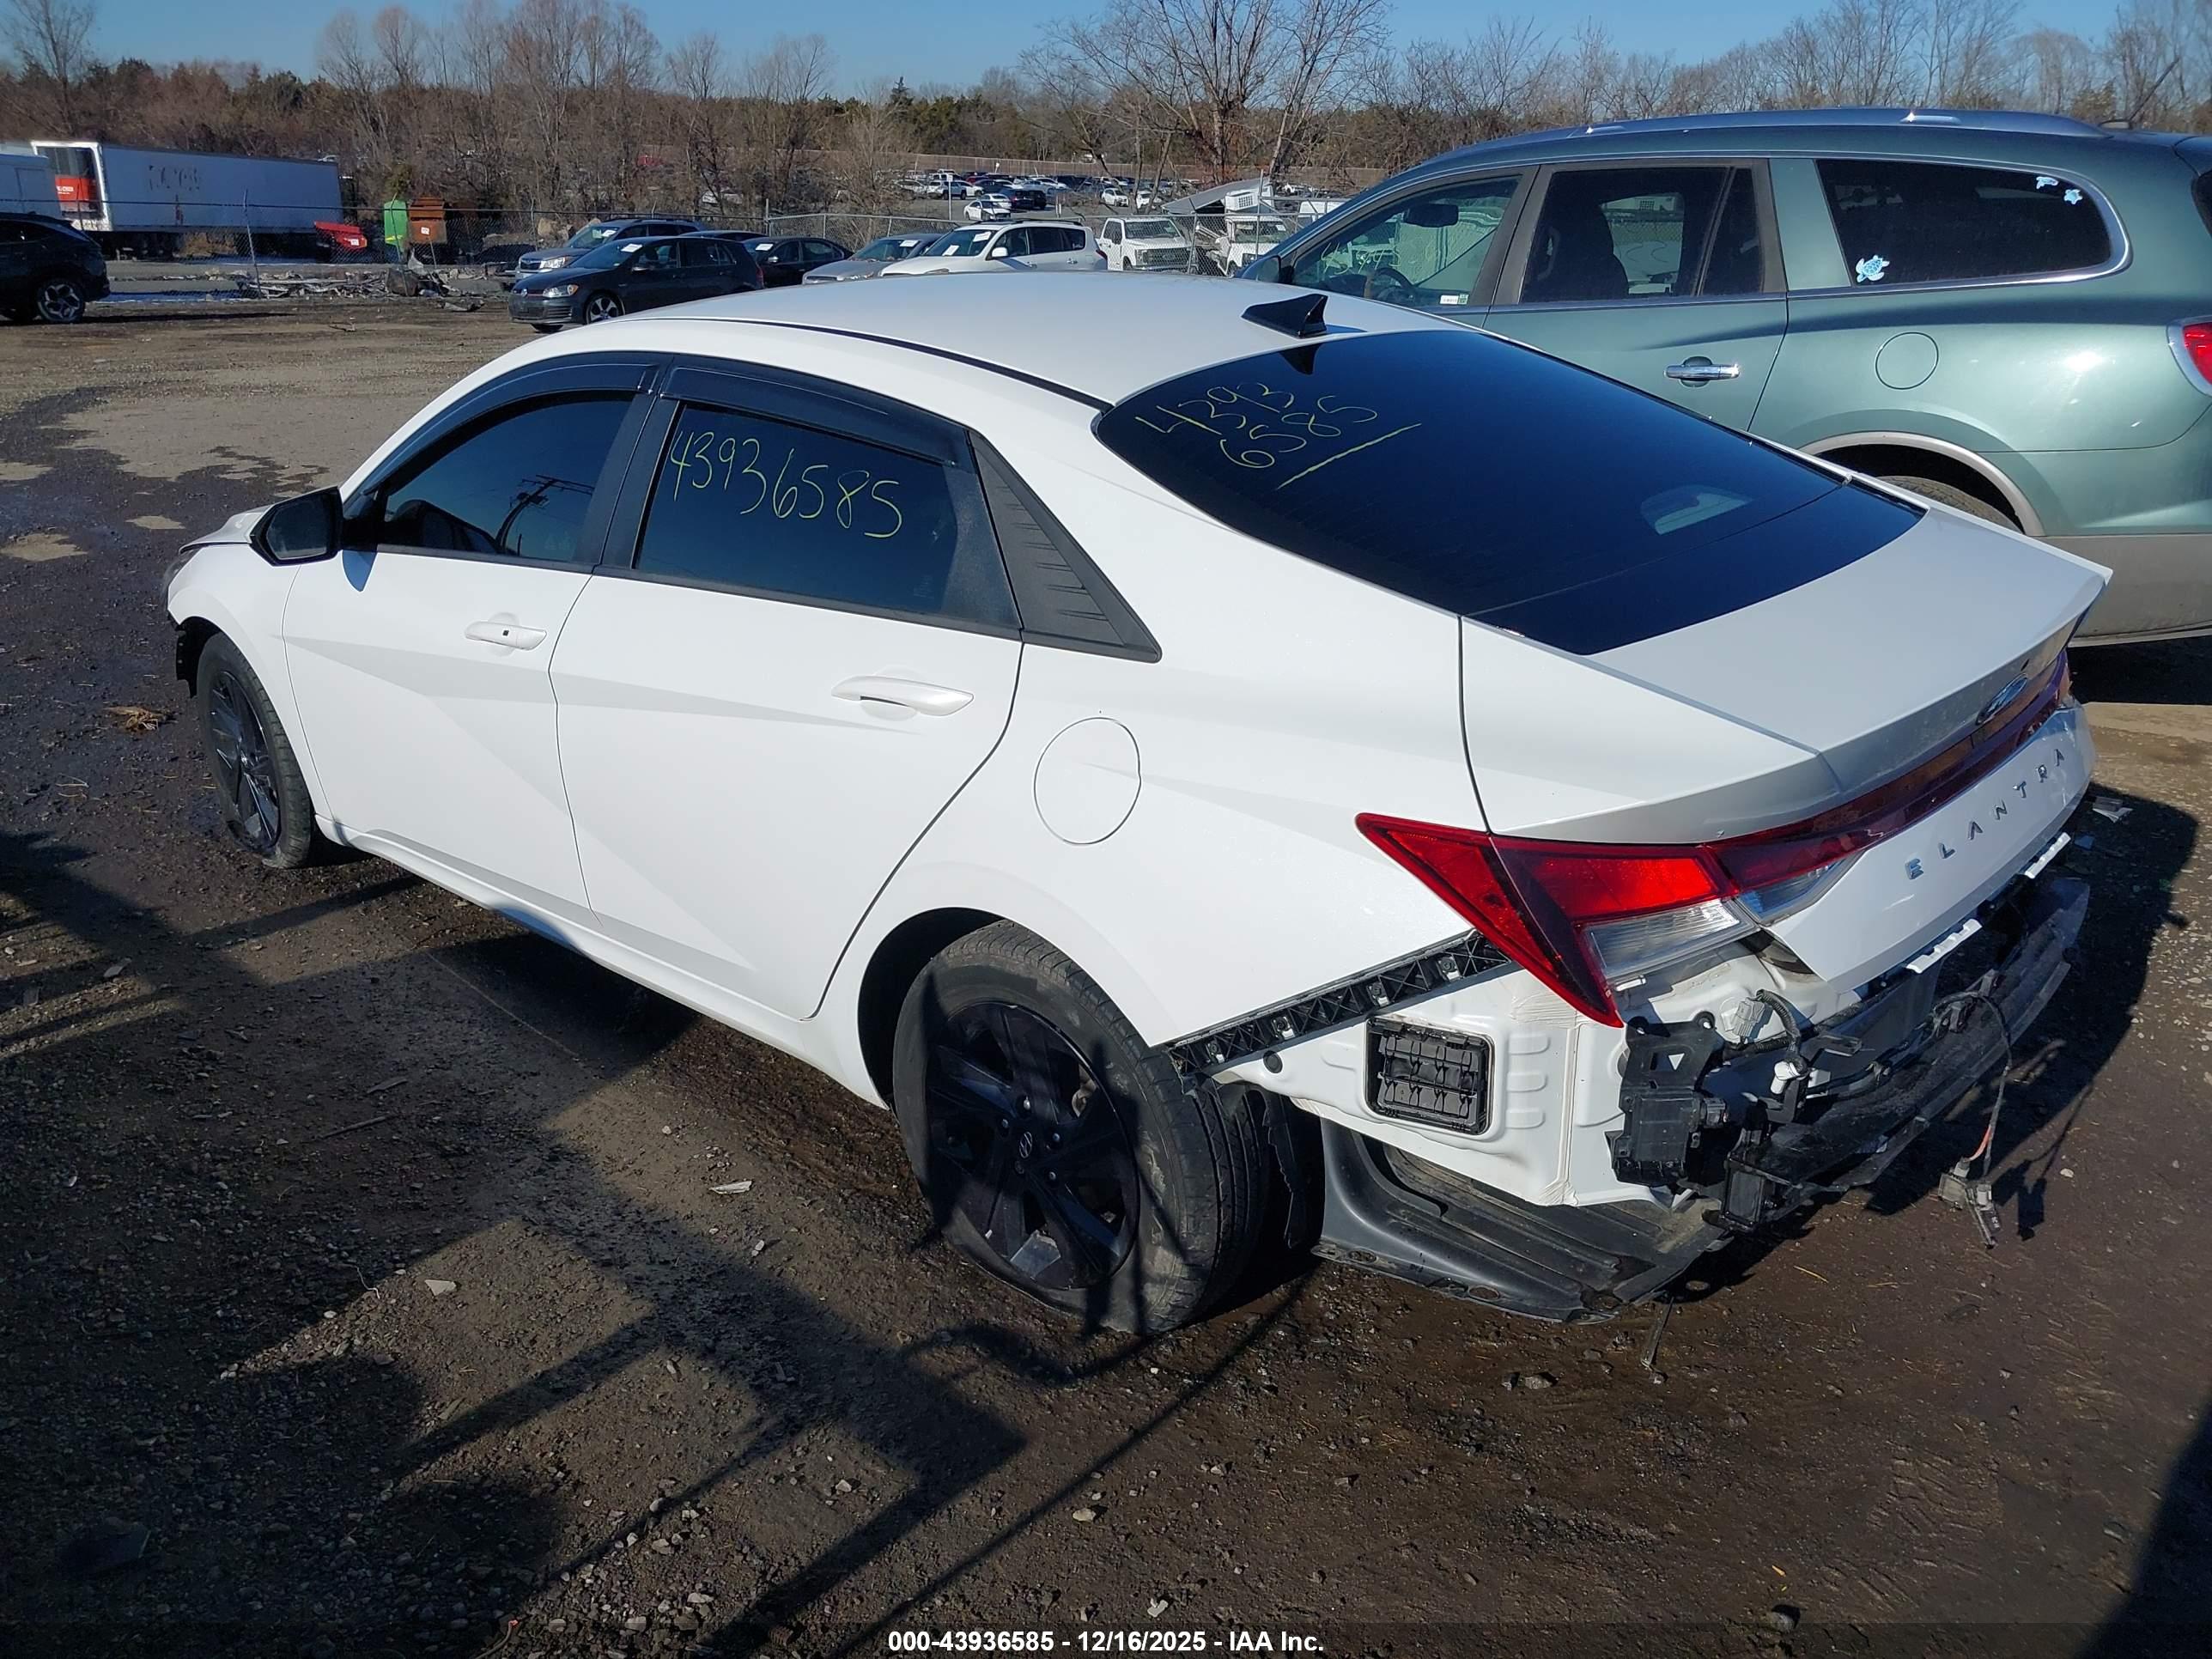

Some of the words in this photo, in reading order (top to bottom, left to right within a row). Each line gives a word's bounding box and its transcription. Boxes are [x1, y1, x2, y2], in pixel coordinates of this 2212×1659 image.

[1134, 382, 1295, 435] 4393
[1219, 395, 1378, 469] 6585
[670, 431, 902, 538] 43936585
[1904, 748, 2065, 881] ELANTRA
